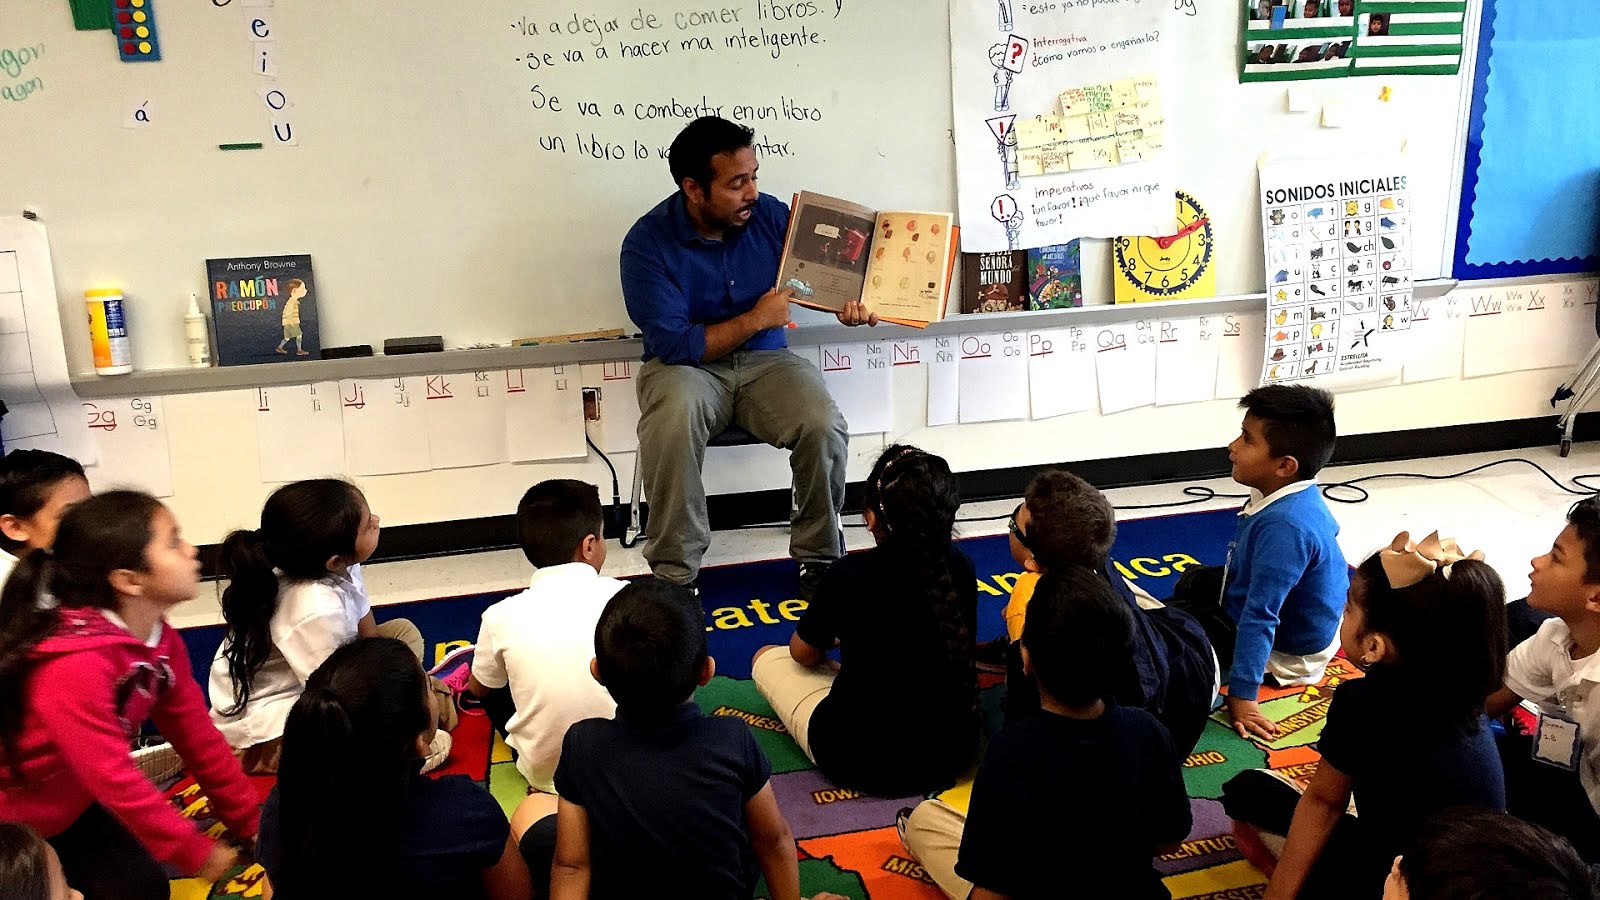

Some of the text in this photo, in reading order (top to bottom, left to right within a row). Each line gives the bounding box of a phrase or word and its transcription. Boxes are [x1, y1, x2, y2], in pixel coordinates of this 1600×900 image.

[251, 18, 270, 38] e
[567, 13, 621, 46] dejar
[630, 8, 664, 31] de
[674, 6, 743, 31] comer
[563, 49, 585, 63] va
[595, 41, 610, 60] a
[620, 40, 671, 61] hacer
[680, 37, 712, 52] ma
[725, 26, 827, 60] inteligente.
[1067, 45, 1097, 59] vamos
[261, 51, 268, 73] i
[530, 84, 562, 112] Se
[577, 101, 601, 117] va
[613, 102, 625, 116] a
[781, 96, 822, 122] libro
[539, 135, 566, 153] un
[576, 132, 625, 161] libro
[634, 139, 649, 160] lo
[1266, 175, 1407, 205] SONIDOS INICIALES
[1122, 239, 1130, 251] 9
[1198, 234, 1206, 246] 3
[227, 260, 297, 272] Anthony Browne
[1128, 258, 1136, 270] 8
[1192, 255, 1200, 265] 4
[980, 269, 1012, 285] MUNDO
[1144, 271, 1152, 284] 7
[1161, 275, 1169, 287] 6
[1180, 268, 1188, 281] 5
[215, 276, 279, 299] RAMÓN
[1471, 294, 1502, 314] Ww
[1528, 289, 1546, 307] Xx
[1070, 327, 1083, 339] Pp
[1160, 321, 1178, 339] Rr
[1224, 315, 1241, 334] Ss
[1003, 332, 1019, 342] Oo
[1097, 330, 1127, 350] Qq
[866, 344, 881, 355] Nn
[961, 336, 991, 356] Oo
[1003, 347, 1021, 357] Oo
[1030, 334, 1053, 358] Pp
[1072, 340, 1086, 352] Pp
[824, 348, 851, 368] Nn
[868, 358, 885, 369] Nn
[474, 371, 489, 381] Kk
[426, 374, 452, 396] Kk
[344, 383, 364, 409] Jj
[131, 399, 152, 413] Gg
[133, 416, 157, 430] Gg
[714, 705, 792, 735] MINNESO
